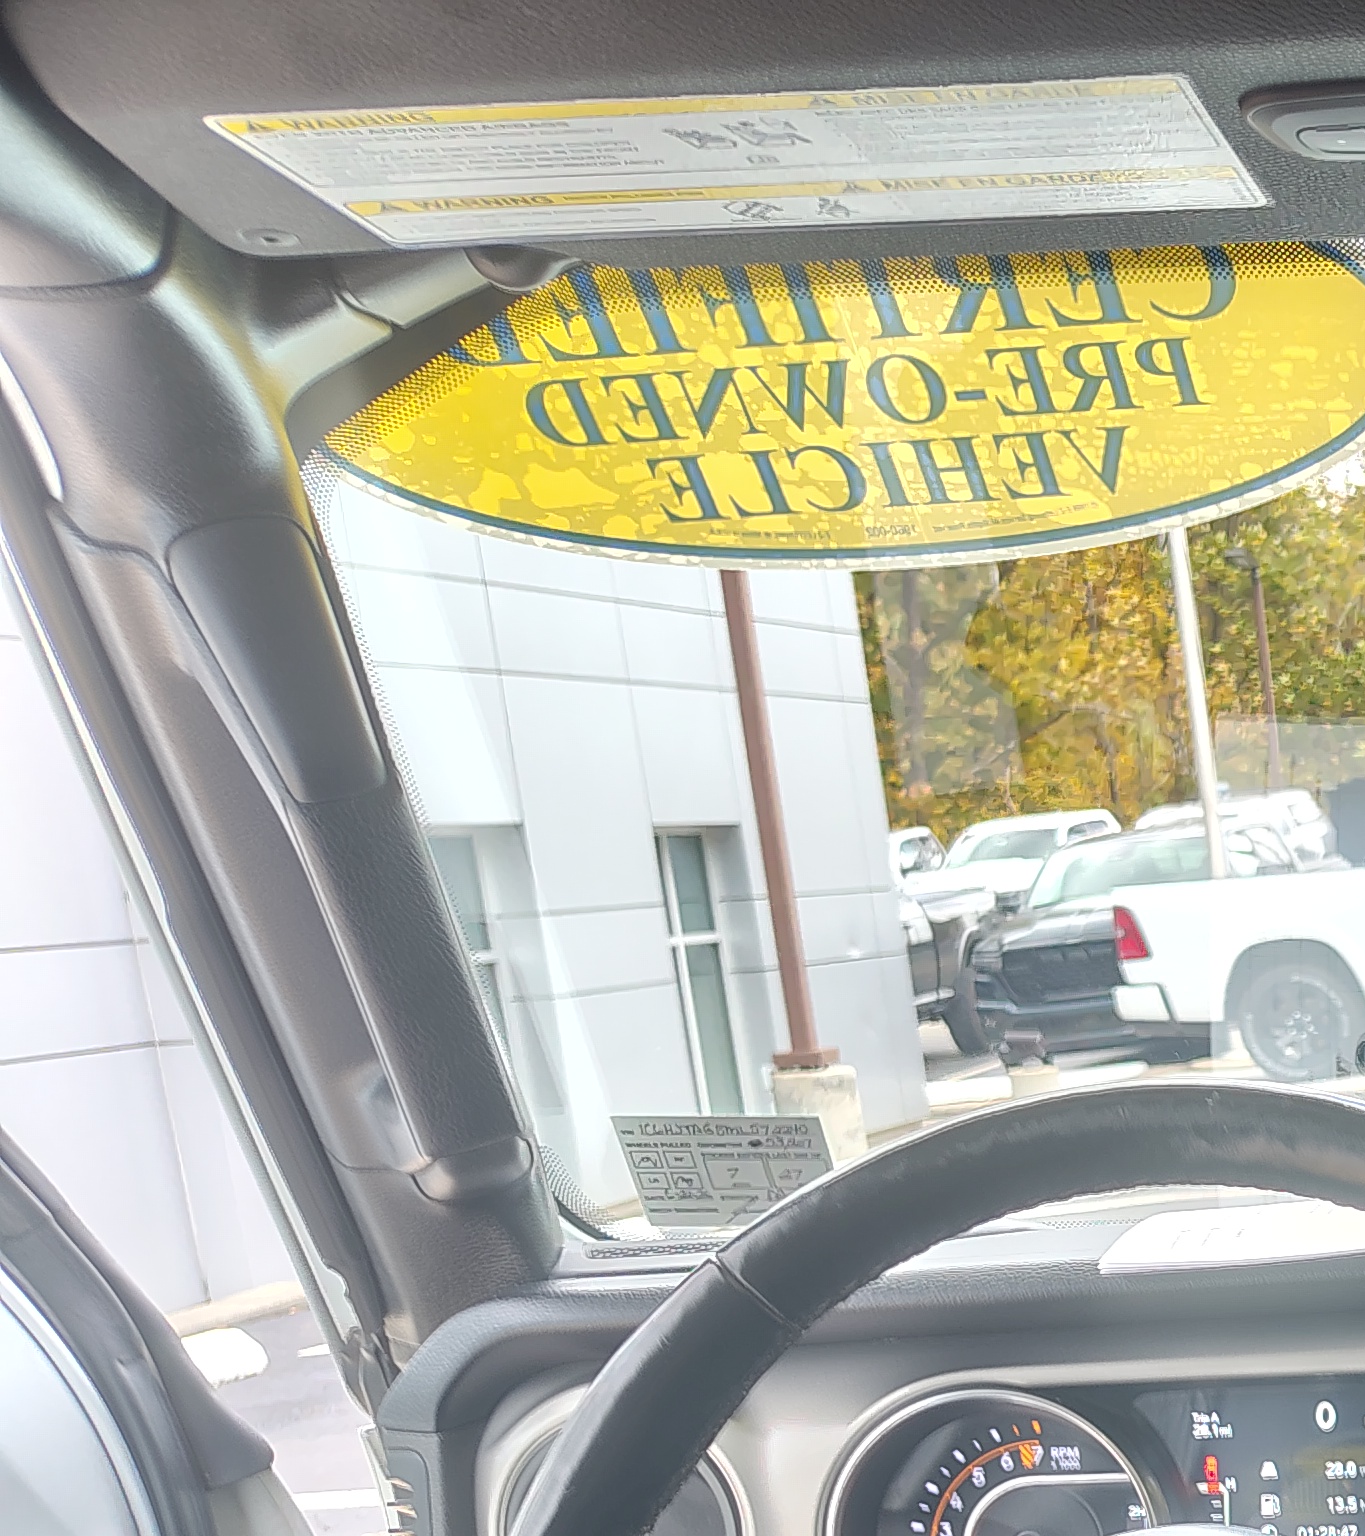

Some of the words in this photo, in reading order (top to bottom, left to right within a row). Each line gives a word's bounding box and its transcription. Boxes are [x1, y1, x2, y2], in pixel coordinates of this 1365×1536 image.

[1315, 1400, 1337, 1432] 0
[1000, 1450, 1015, 1472] 6
[1050, 1446, 1080, 1462] RPM
[971, 1466, 987, 1488] 5
[949, 1491, 964, 1512] 4
[1326, 1496, 1358, 1514] 13.5
